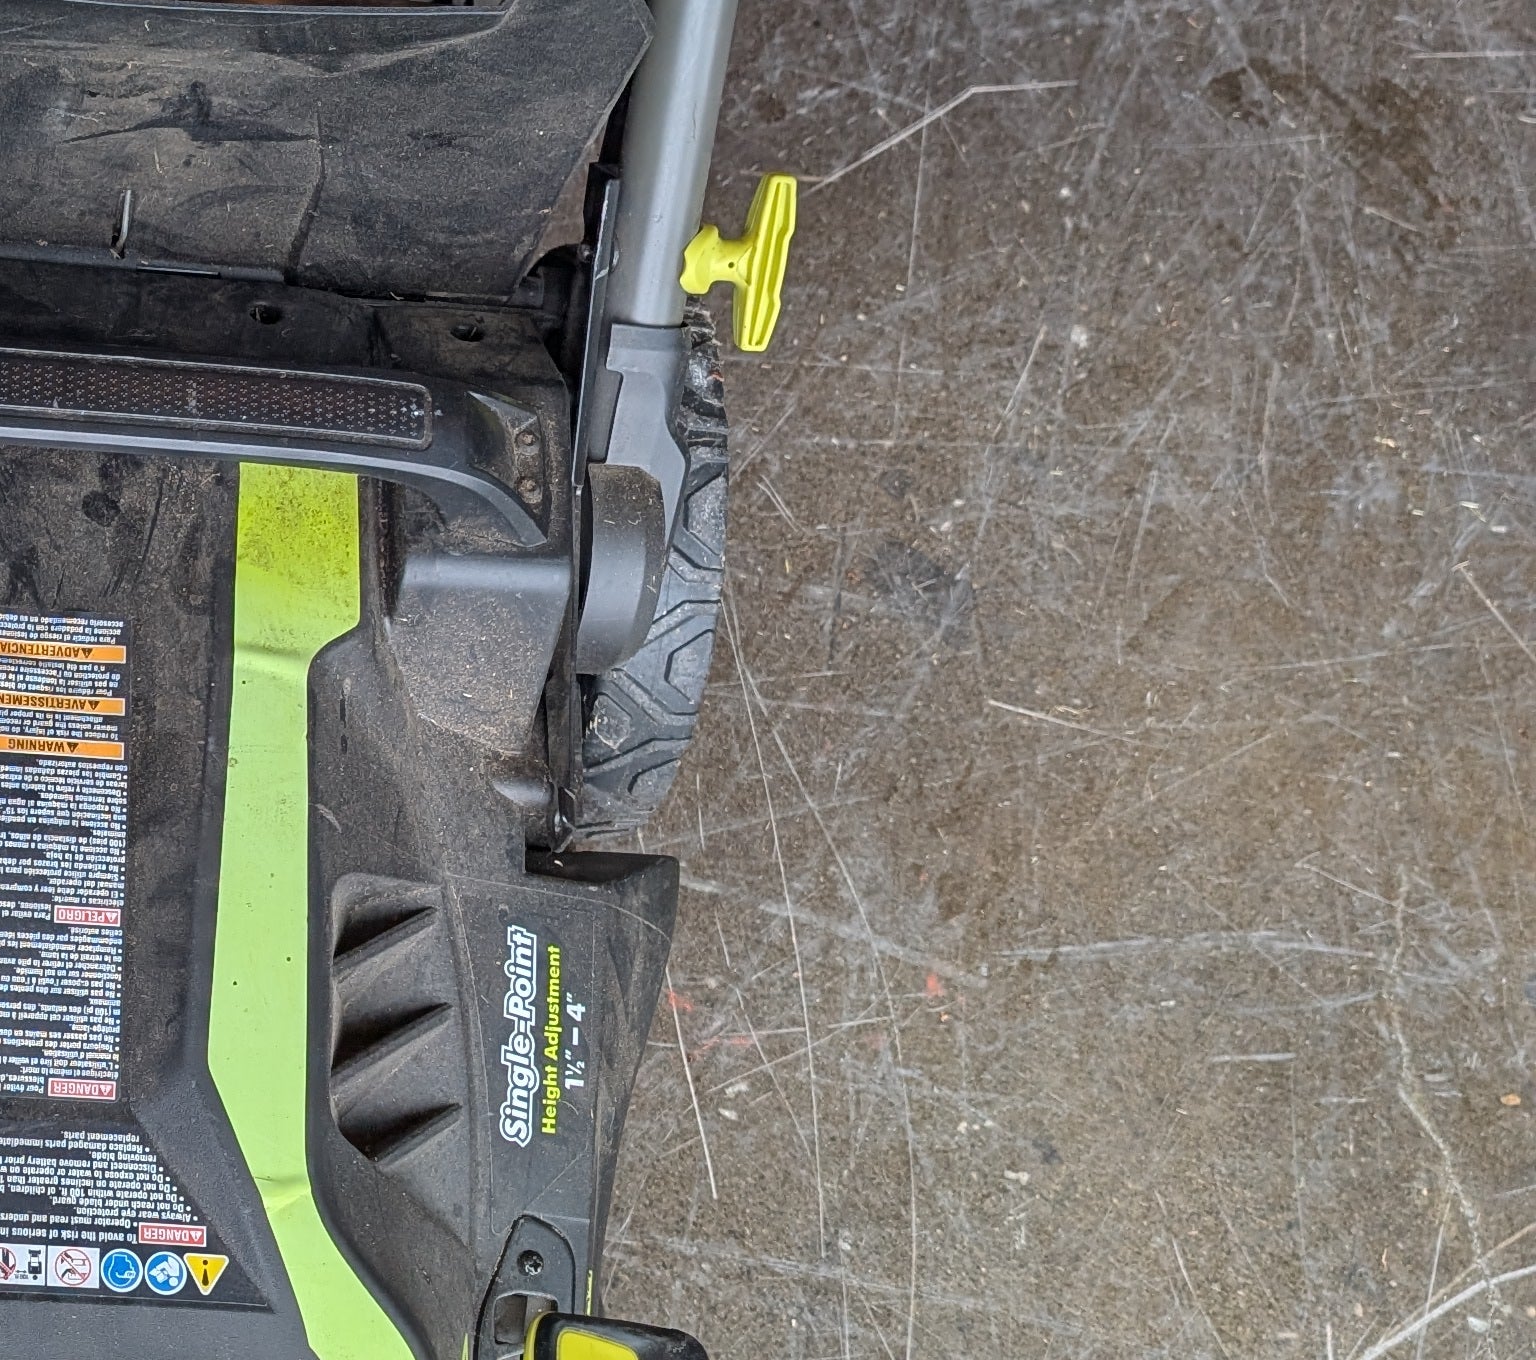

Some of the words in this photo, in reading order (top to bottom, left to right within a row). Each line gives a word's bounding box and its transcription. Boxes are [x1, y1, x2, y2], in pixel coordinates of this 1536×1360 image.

[0, 641, 79, 657] ADVERTENCIA
[7, 738, 64, 752] WARNING
[57, 908, 105, 922] PELIGRO
[544, 945, 562, 1060] Adjustment
[501, 926, 538, 1143] Single-Point
[52, 1081, 99, 1095] DANGER
[542, 1064, 561, 1134] Height
[86, 1130, 139, 1142] replacement
[44, 1138, 66, 1149] parts
[67, 1139, 107, 1151] damaged
[108, 1141, 142, 1153] Replace
[3, 1154, 25, 1165] prior
[26, 1155, 56, 1167] battery
[117, 1150, 157, 1162] removing
[58, 1158, 90, 1167] remove
[92, 1160, 108, 1169] and
[110, 1161, 156, 1172] Disconnect
[22, 1165, 54, 1176] operate
[67, 1169, 92, 1178] water
[93, 1170, 102, 1179] to
[104, 1169, 134, 1179] expose
[6, 1175, 25, 1184] than
[27, 1174, 58, 1186] greater
[135, 1172, 149, 1181] not
[151, 1173, 163, 1182] Do
[60, 1178, 93, 1188] inclines
[95, 1179, 106, 1187] on
[108, 1179, 141, 1190] operate
[142, 1182, 156, 1191] not
[158, 1183, 170, 1192] Do
[46, 1187, 55, 1196] of
[69, 1188, 85, 1197] 100
[87, 1189, 114, 1199] within
[115, 1189, 148, 1200] operate
[149, 1192, 163, 1201] not
[78, 1197, 102, 1207] blade
[165, 1193, 177, 1202] Do
[104, 1199, 129, 1208] under
[130, 1200, 154, 1210] reach
[156, 1202, 170, 1211] not
[172, 1203, 184, 1211] Do
[120, 1207, 136, 1217] eye
[137, 1210, 159, 1218] wear
[160, 1209, 191, 1221] Always
[31, 1214, 47, 1223] and
[49, 1215, 68, 1224] read
[70, 1216, 92, 1225] must
[93, 1215, 131, 1227] Operator
[11, 1227, 46, 1239] serious
[48, 1229, 58, 1240] of
[60, 1229, 78, 1240] risk
[80, 1230, 96, 1241] the
[98, 1231, 124, 1242] avoid
[126, 1232, 137, 1243] To
[142, 1227, 189, 1241] DANGER
